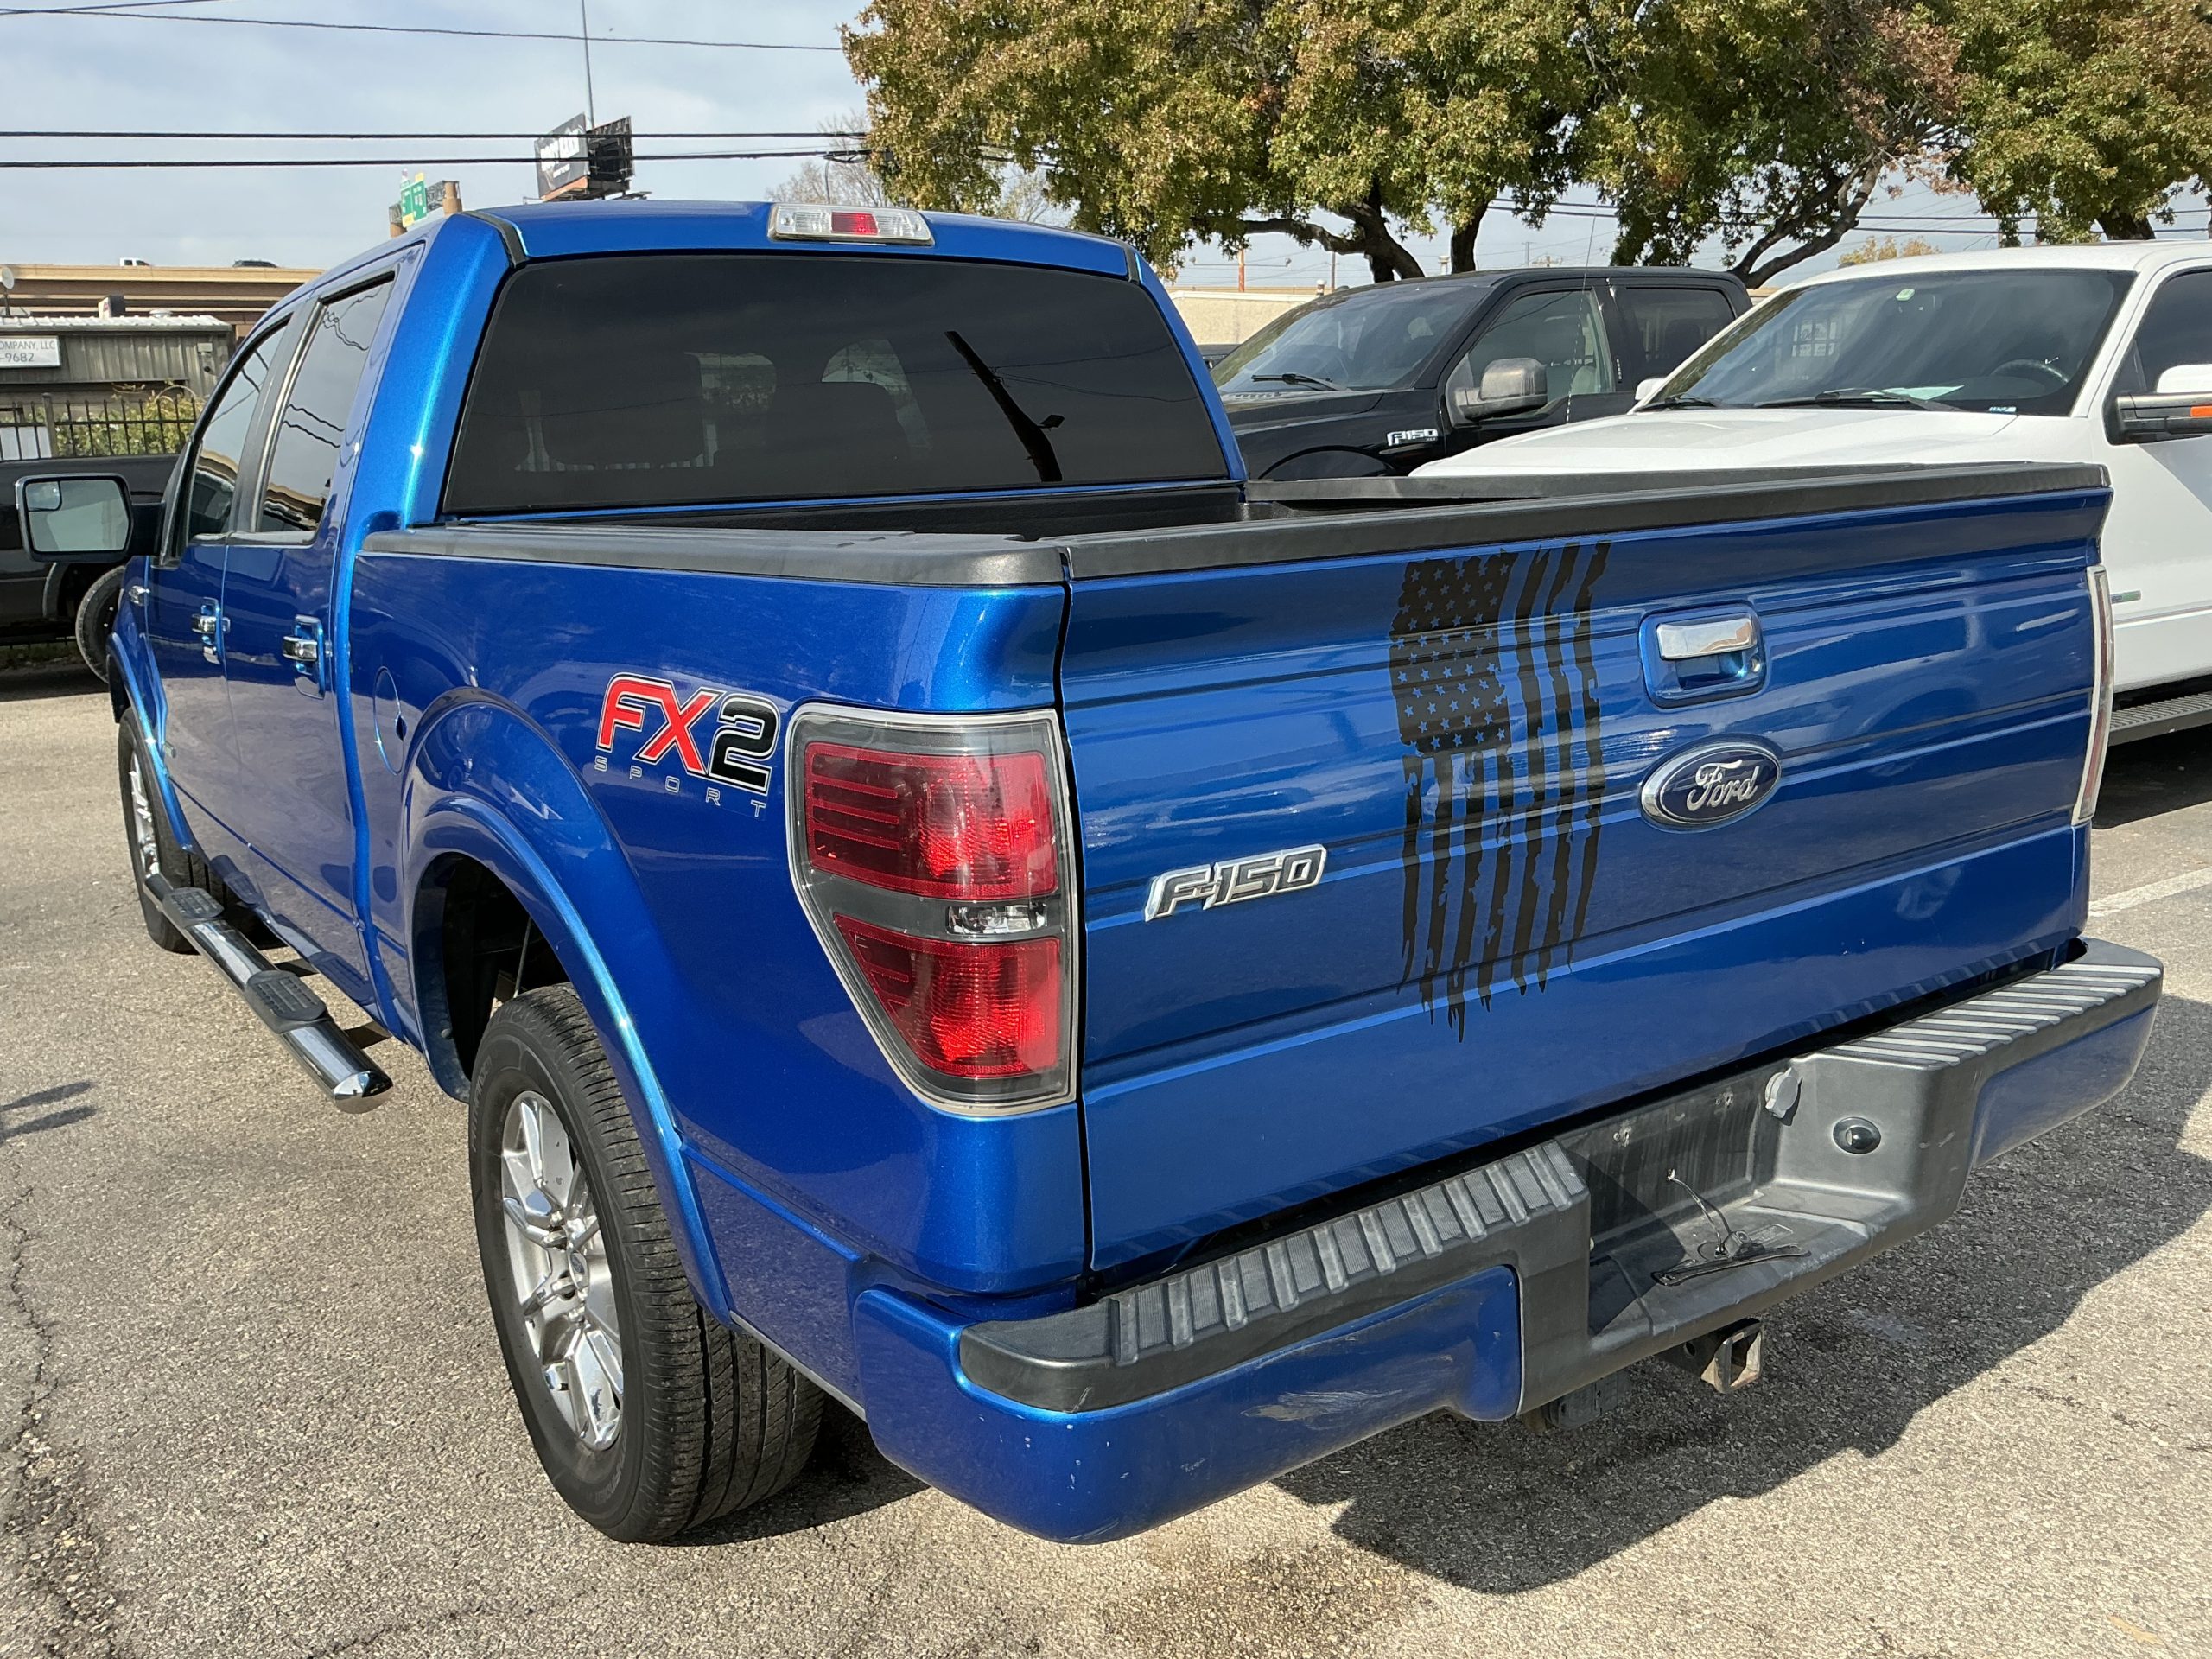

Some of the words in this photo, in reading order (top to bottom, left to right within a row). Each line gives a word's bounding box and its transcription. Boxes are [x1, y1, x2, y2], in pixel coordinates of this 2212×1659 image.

[40, 340, 55, 350] LLC
[596, 672, 781, 796] FX2
[594, 755, 766, 817] SPORT
[1686, 759, 1760, 812] Ford
